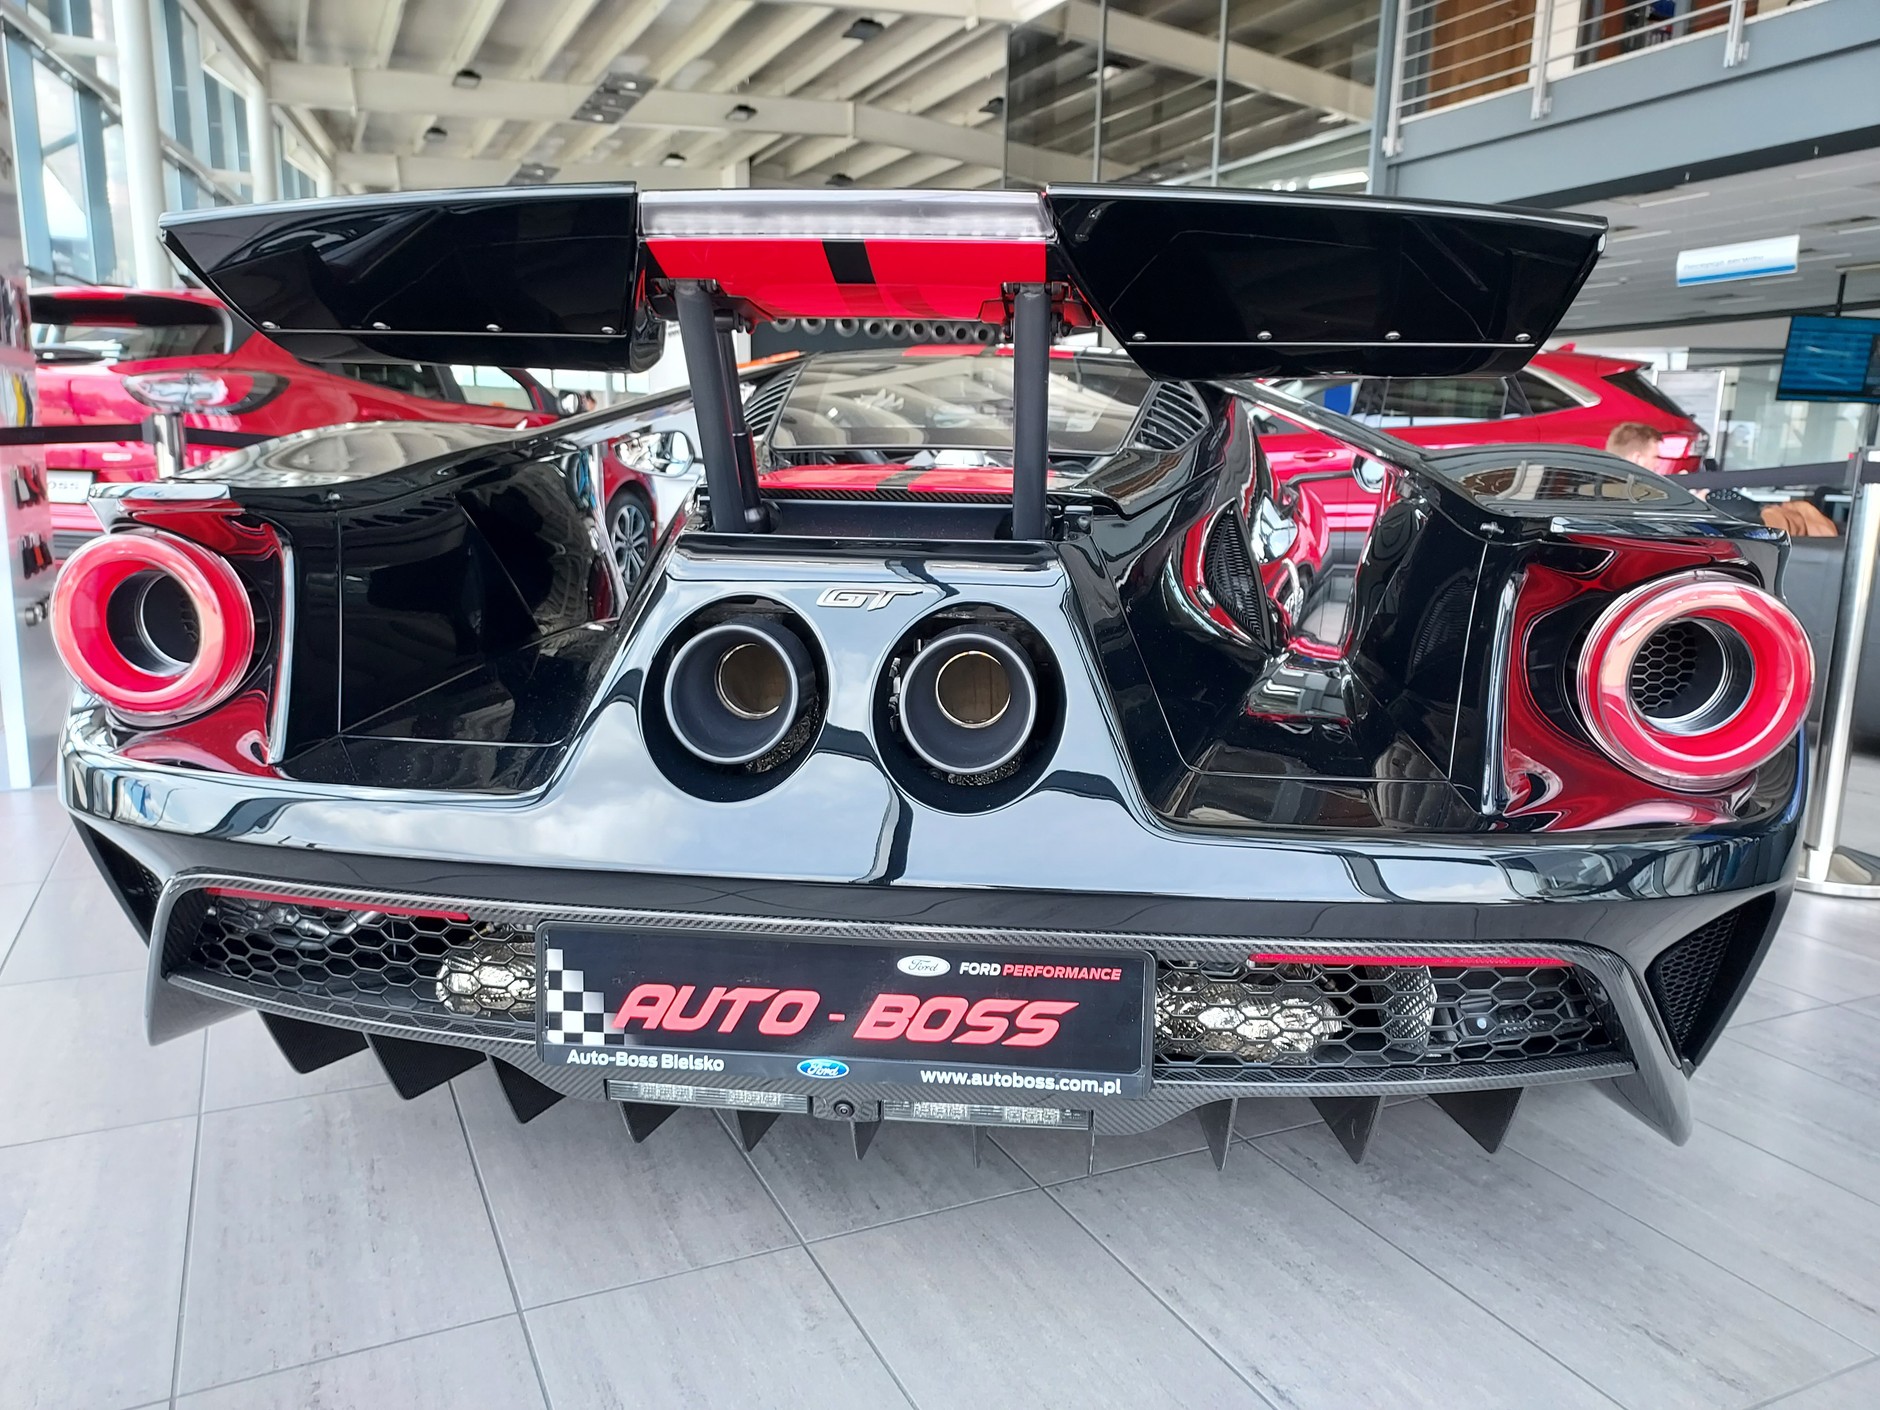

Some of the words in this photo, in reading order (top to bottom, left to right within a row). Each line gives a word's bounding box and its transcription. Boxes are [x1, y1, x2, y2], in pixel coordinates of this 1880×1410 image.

[816, 587, 923, 611] GT
[959, 962, 1001, 976] FORD
[1002, 963, 1122, 981] PERFORMANCE
[611, 983, 821, 1036] AUTO
[853, 993, 1080, 1047] BOSS
[566, 1049, 658, 1069] Auto-Boss
[661, 1053, 725, 1072] Bielsko
[920, 1069, 1122, 1096] www.autoboss.com.pl
